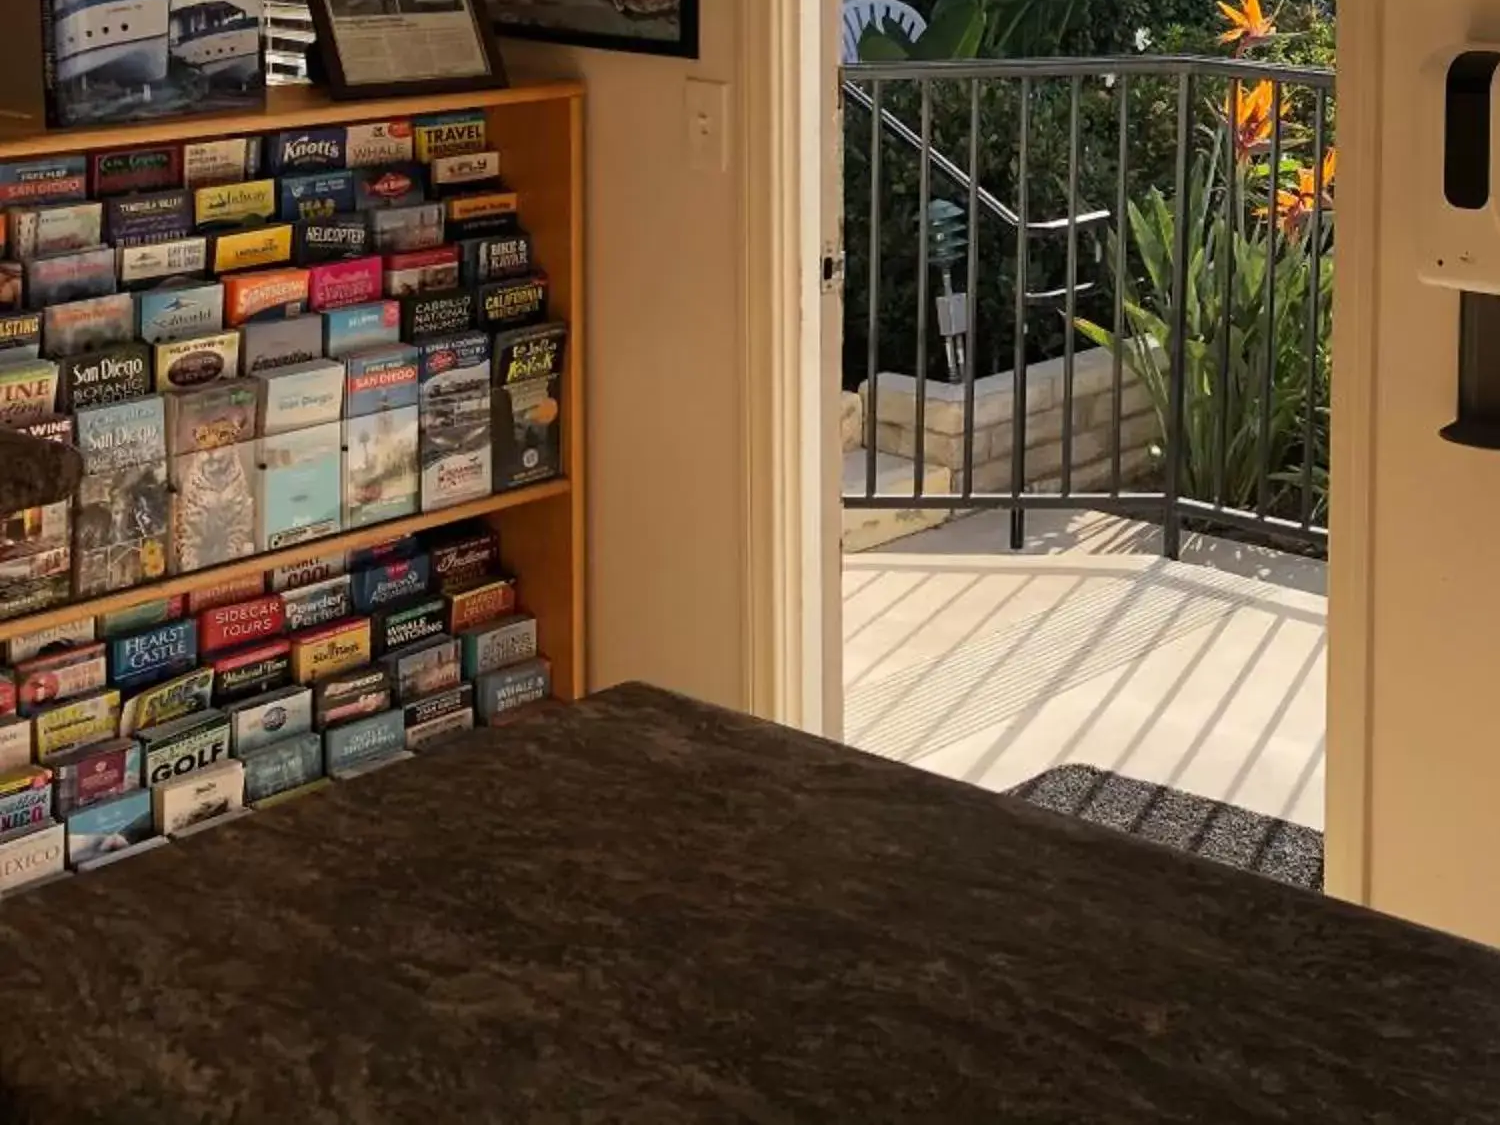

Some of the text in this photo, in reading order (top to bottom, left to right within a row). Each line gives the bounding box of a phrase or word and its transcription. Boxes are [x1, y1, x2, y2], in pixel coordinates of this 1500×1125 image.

[424, 124, 483, 144] TRAVEL
[284, 137, 340, 164] Knott's
[353, 145, 406, 159] WHALE
[8, 181, 80, 198] SAN DIEGO
[306, 225, 367, 244] HELICOPTER
[73, 357, 143, 386] San Diego
[355, 369, 416, 390] SAN DIEGO
[29, 420, 73, 437] WINE
[87, 429, 113, 450] San
[215, 601, 280, 625] SIDECAR
[222, 617, 273, 638] TOURS
[126, 626, 186, 655] HEARST
[130, 640, 187, 669] CASTLE
[152, 741, 225, 783] GOLF
[0, 845, 60, 879] EXICO
